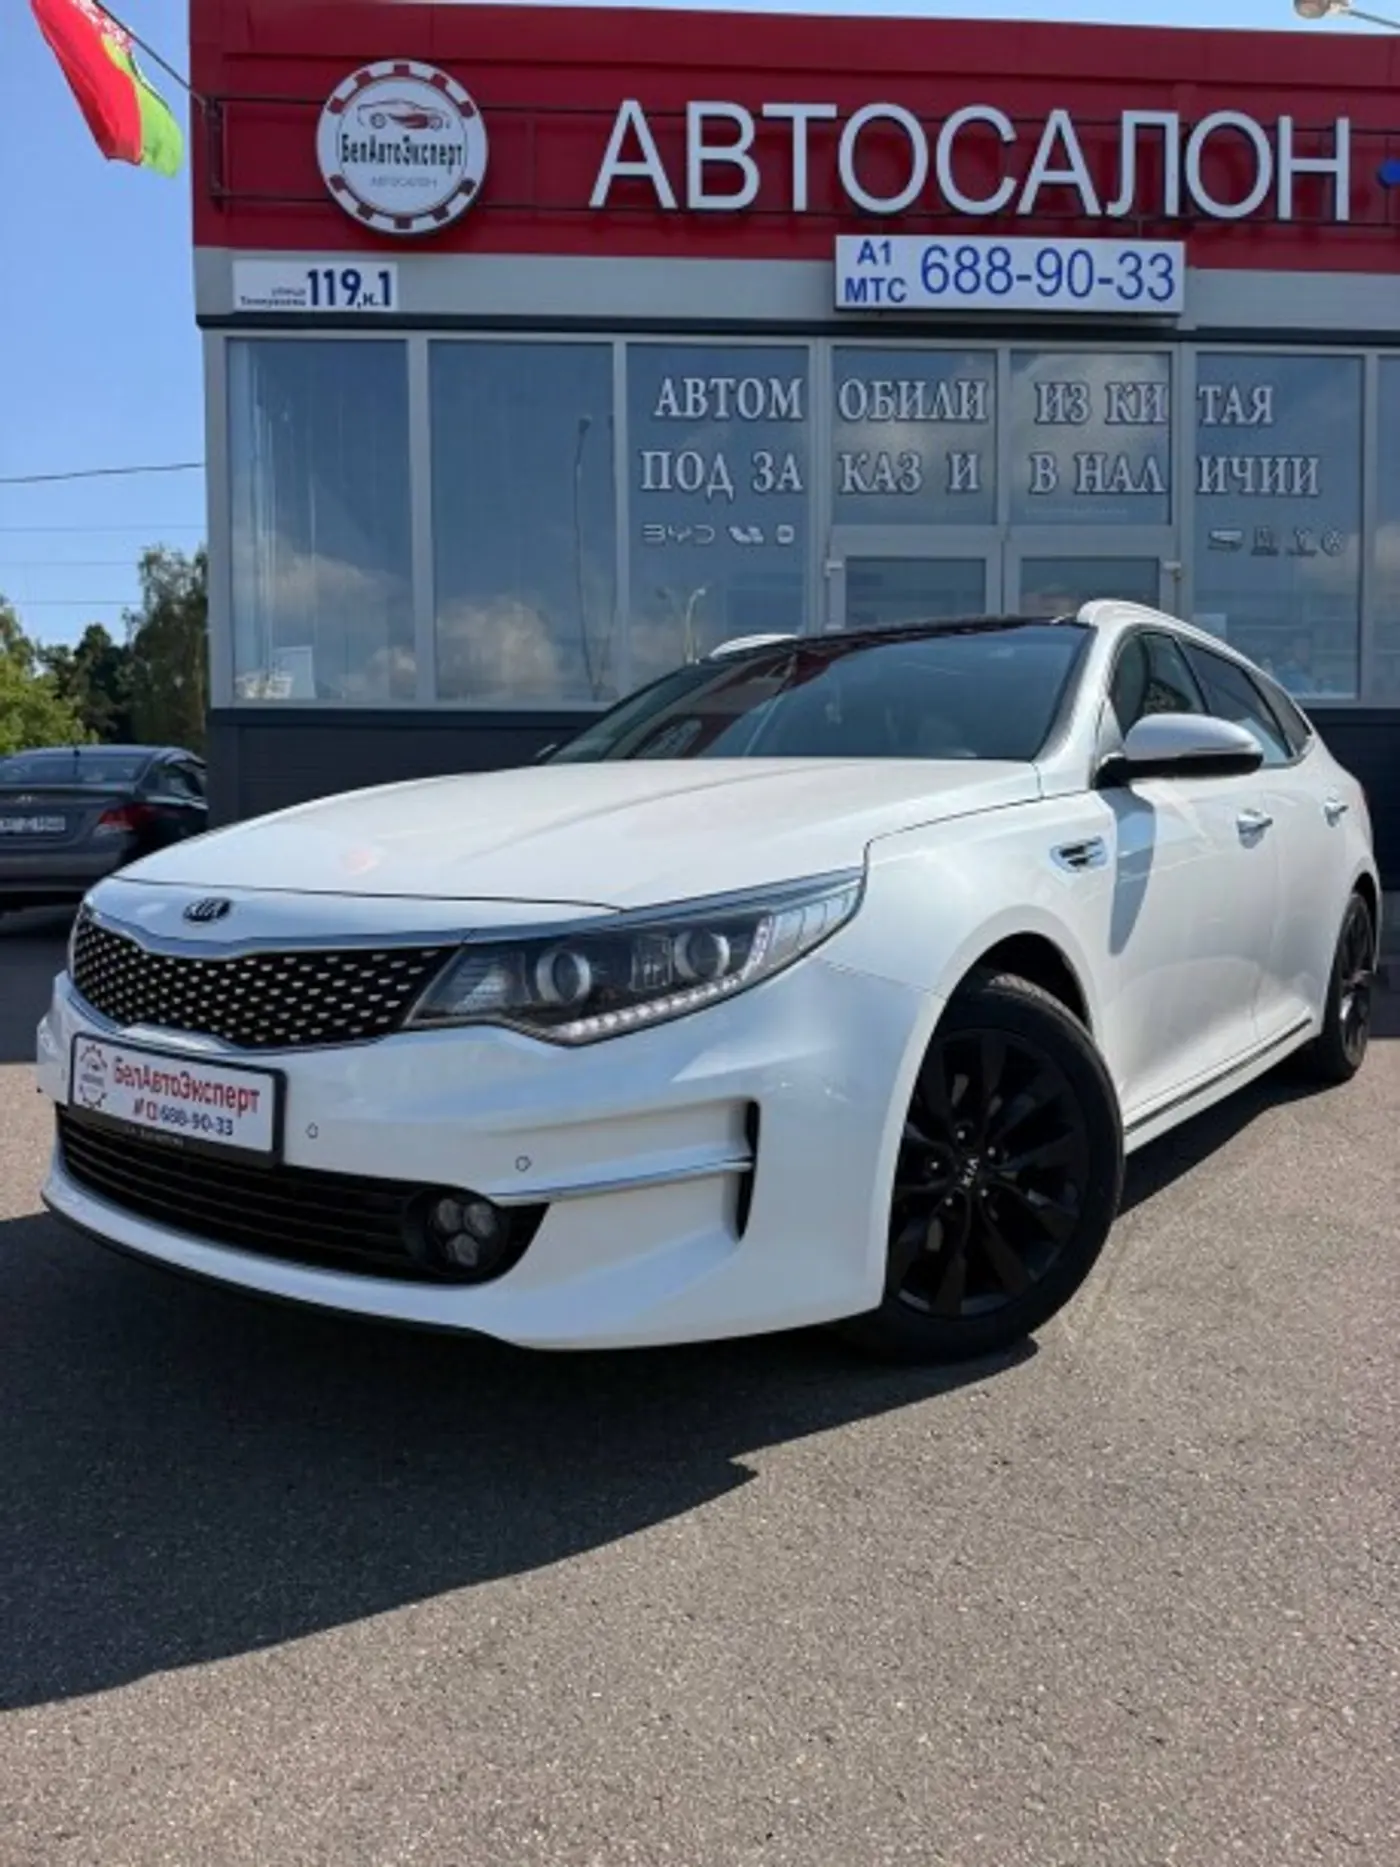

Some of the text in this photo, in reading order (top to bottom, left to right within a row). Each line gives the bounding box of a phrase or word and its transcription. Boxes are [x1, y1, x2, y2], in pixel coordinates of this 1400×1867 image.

[341, 133, 462, 175] БелАвтоЭксперт
[589, 99, 1350, 222] АВТОСАЛОН
[844, 277, 907, 303] МТС
[920, 244, 1175, 302] 688-90-33
[1035, 382, 1090, 424] ИЗ
[641, 451, 735, 502] ПОД
[1029, 452, 1059, 494] В
[113, 1056, 260, 1118] БелАвтоЭксперт
